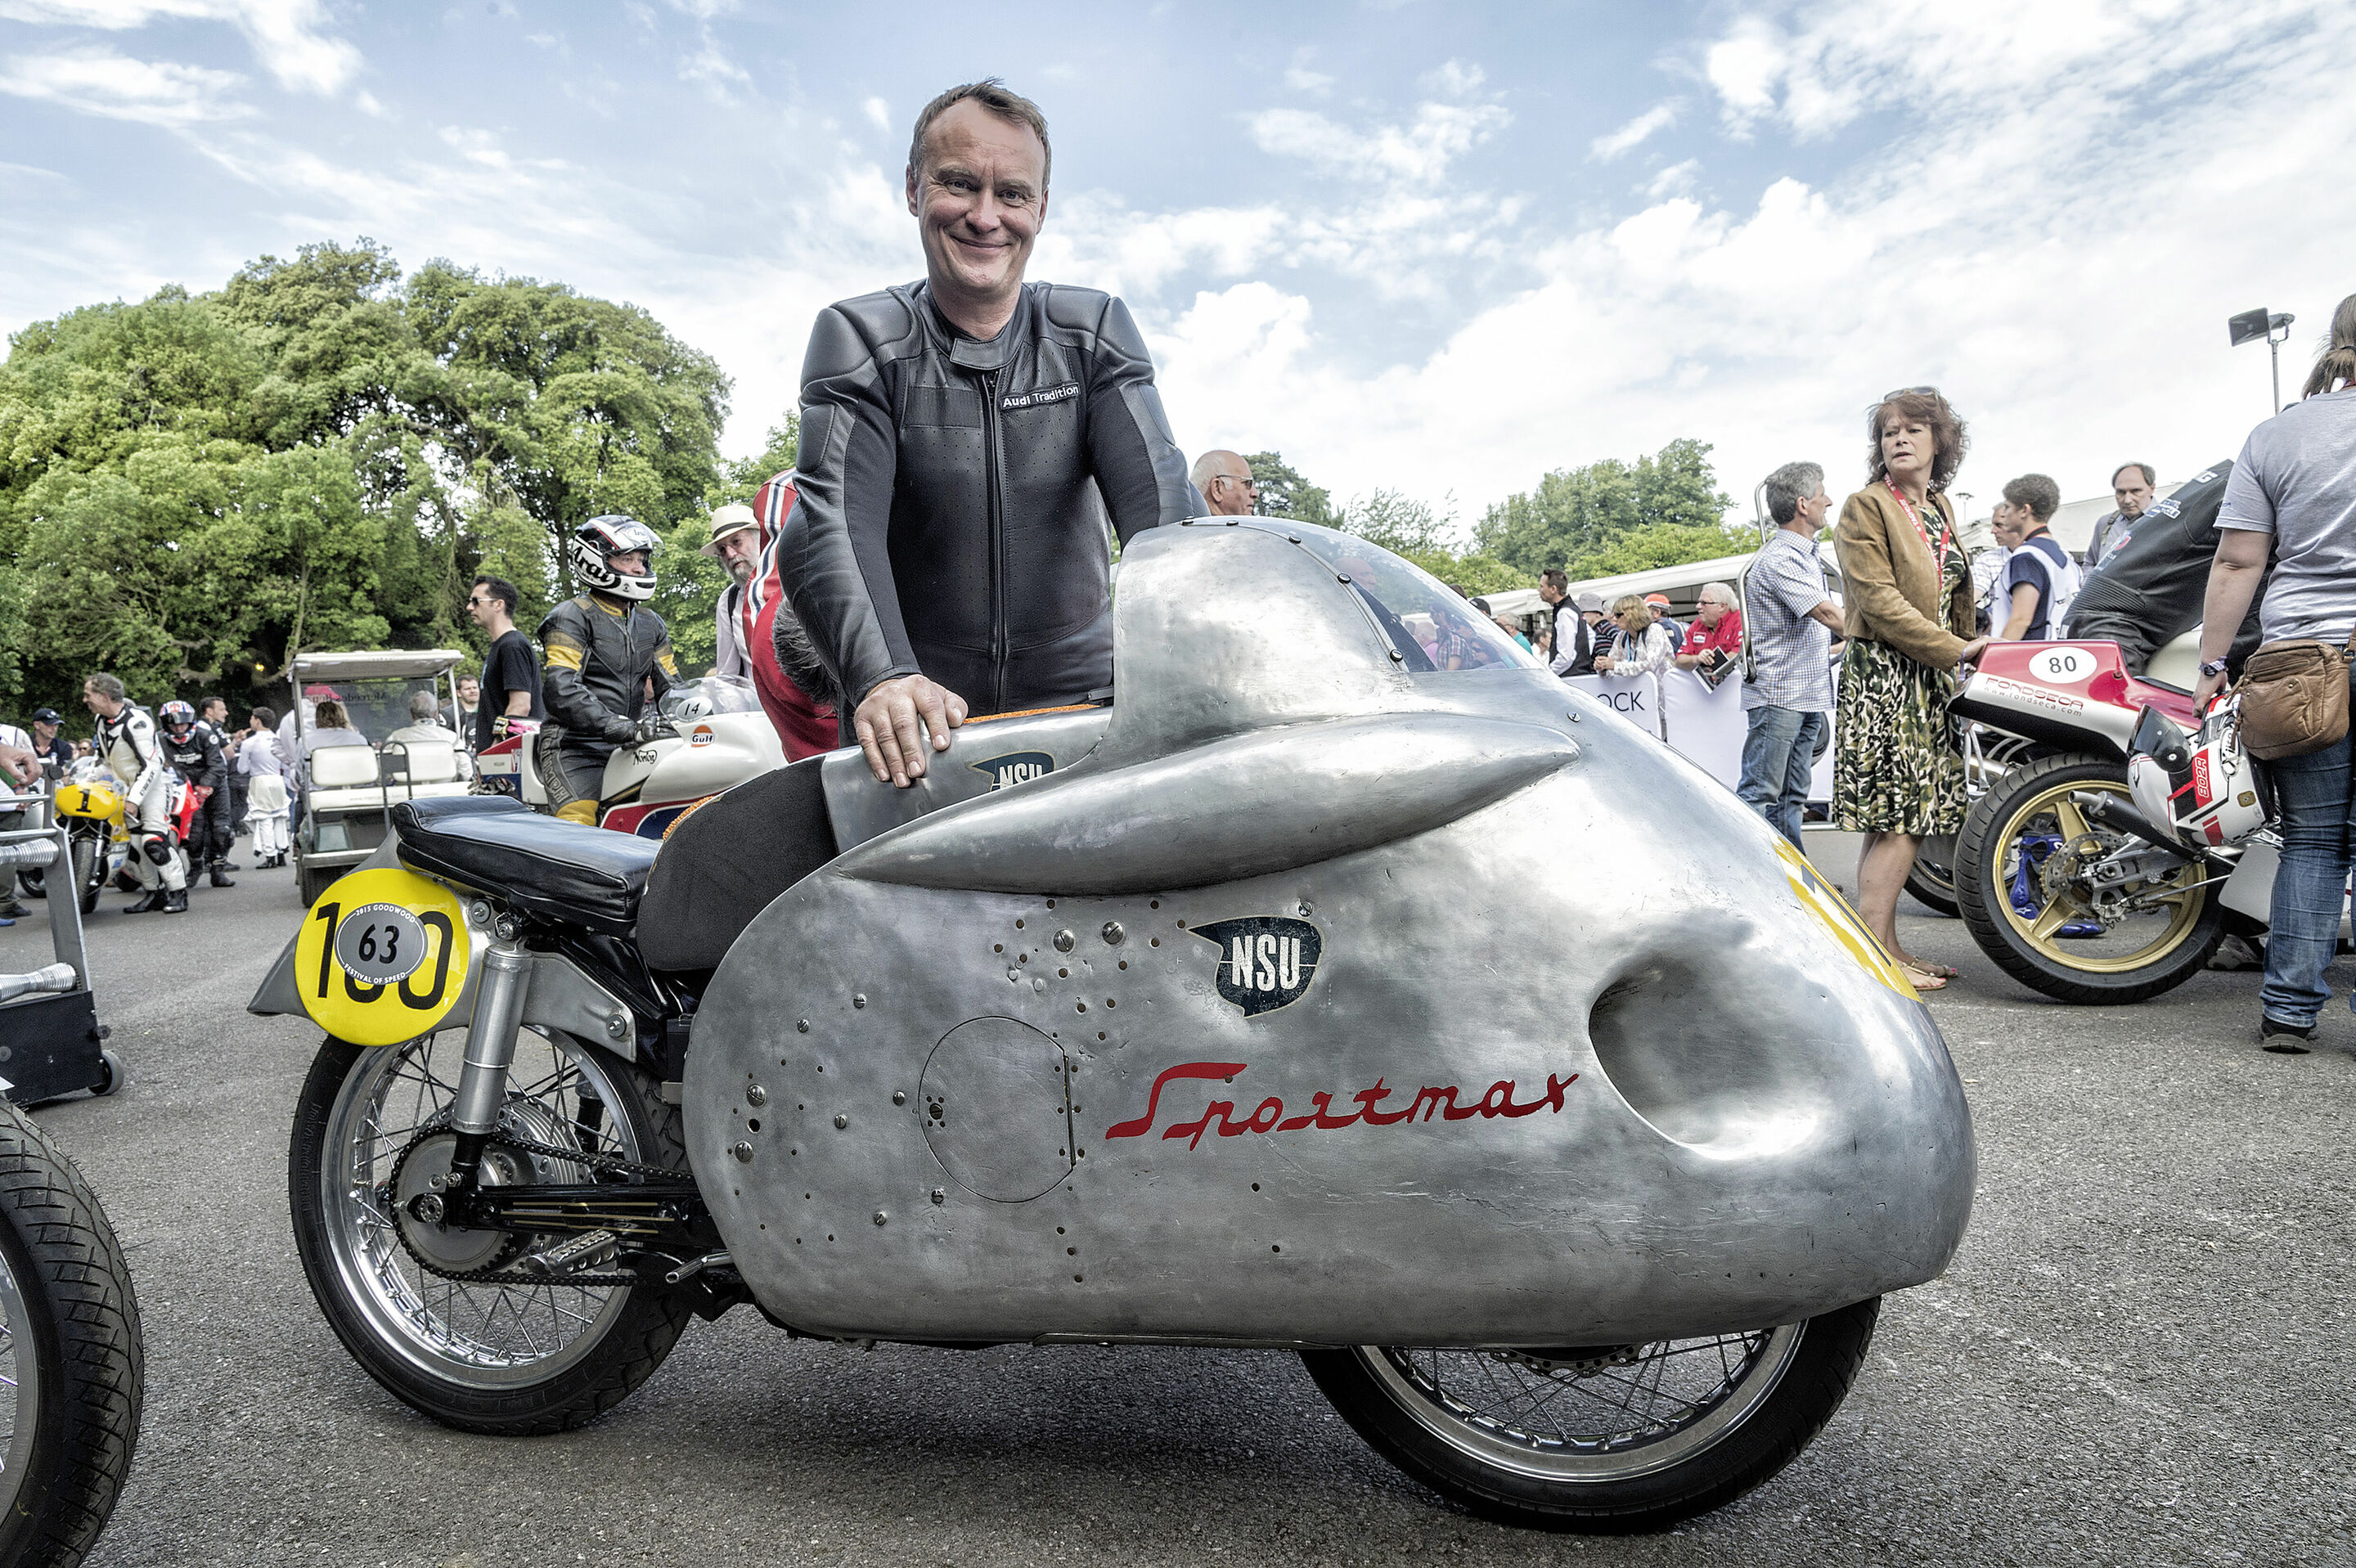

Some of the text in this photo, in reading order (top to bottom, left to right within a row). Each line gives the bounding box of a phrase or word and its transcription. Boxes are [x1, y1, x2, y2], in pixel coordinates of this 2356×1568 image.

[1003, 385, 1079, 408] Audi Tradition
[573, 546, 611, 582] Arai
[2048, 655, 2077, 674] 80
[1985, 676, 2084, 711] FONDSECA
[684, 702, 701, 717] 14
[691, 735, 714, 744] Gulf
[75, 788, 92, 814] 1
[356, 904, 416, 923] 2015 GOODWOOD
[358, 923, 400, 964] 63
[344, 963, 372, 983] FESTIVAL
[384, 971, 407, 984] SPEED
[1231, 934, 1301, 991] NSU
[1105, 1062, 1580, 1152] Sportmax
